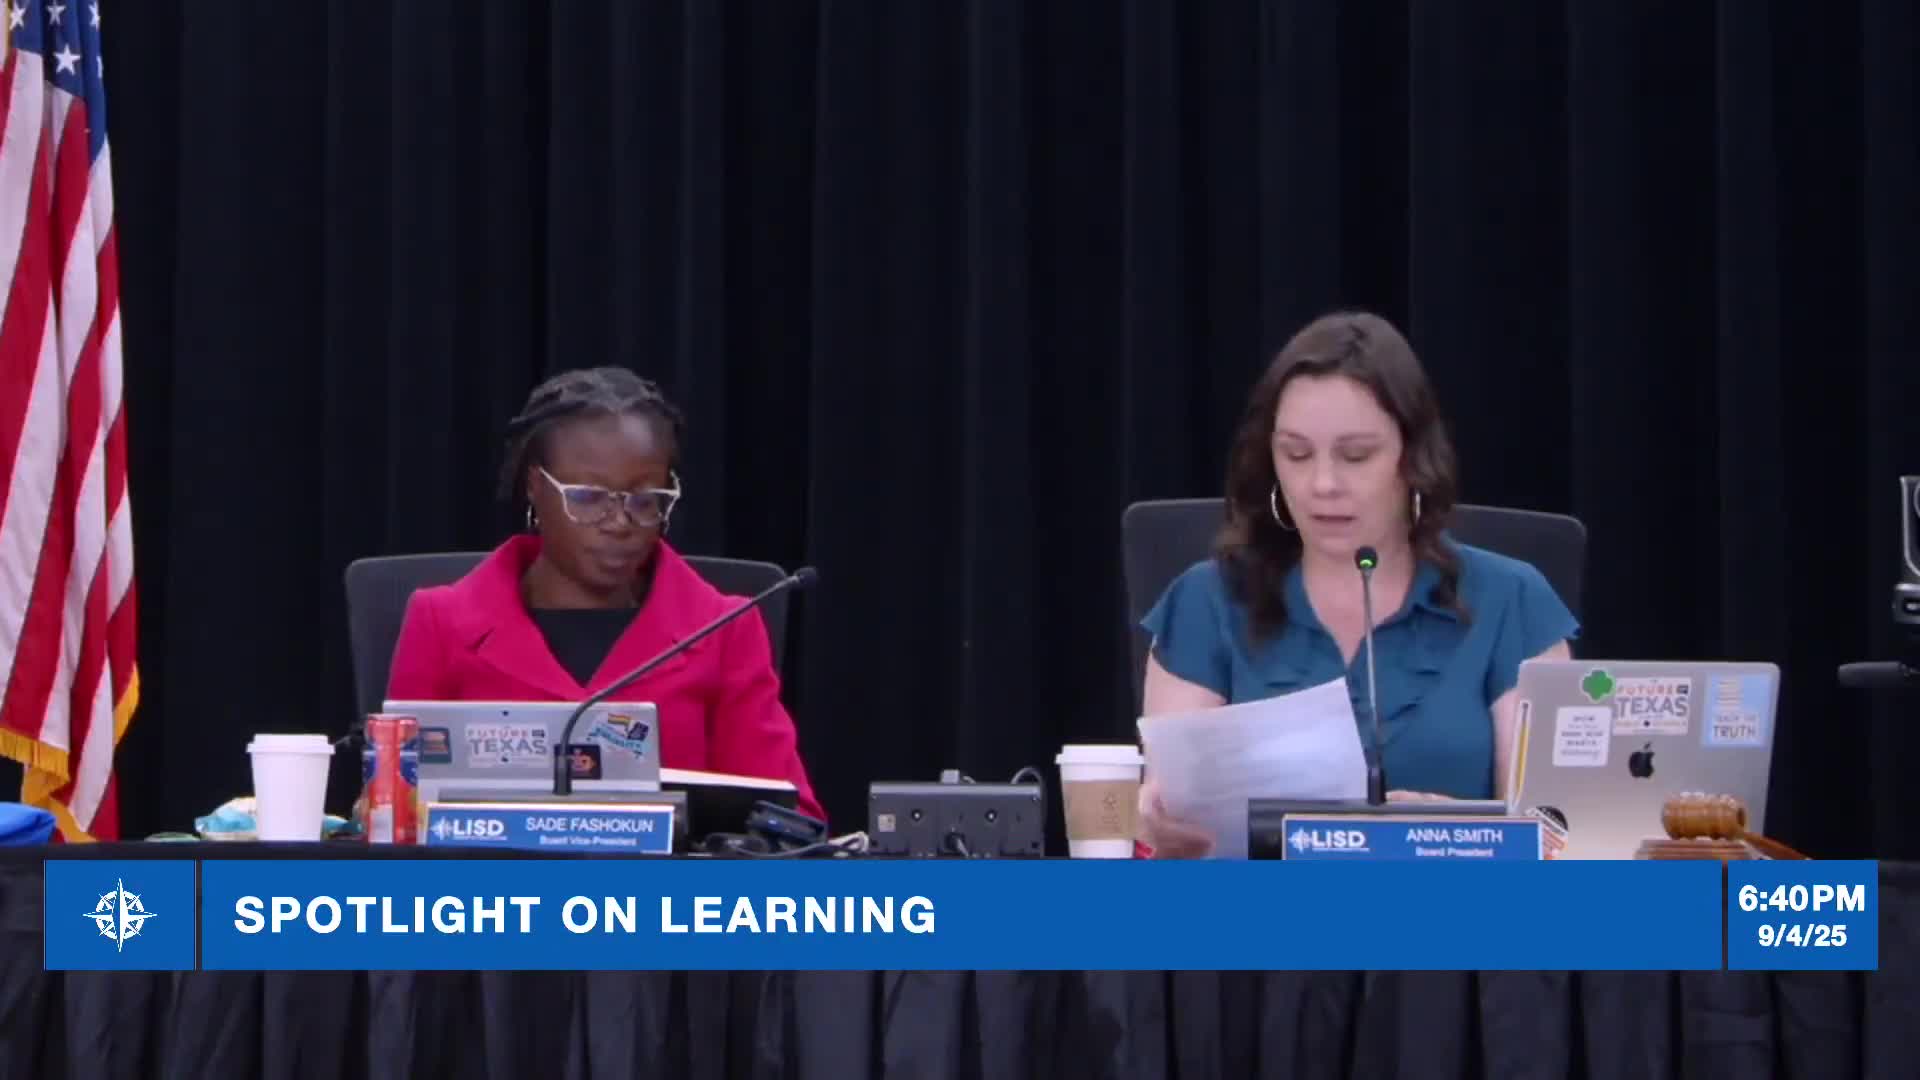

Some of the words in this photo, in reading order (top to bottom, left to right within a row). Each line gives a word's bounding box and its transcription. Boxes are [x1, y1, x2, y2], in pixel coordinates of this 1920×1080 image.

[1616, 696, 1688, 718] TEXAS
[1713, 727, 1756, 739] TRUTH
[468, 737, 548, 756] TEXAS
[453, 819, 504, 837] LISD
[526, 817, 567, 832] SADE
[570, 817, 653, 833] FASHOKUN
[1312, 829, 1365, 847] LISD
[1406, 828, 1451, 843] ANNA
[1453, 828, 1503, 843] SMITH
